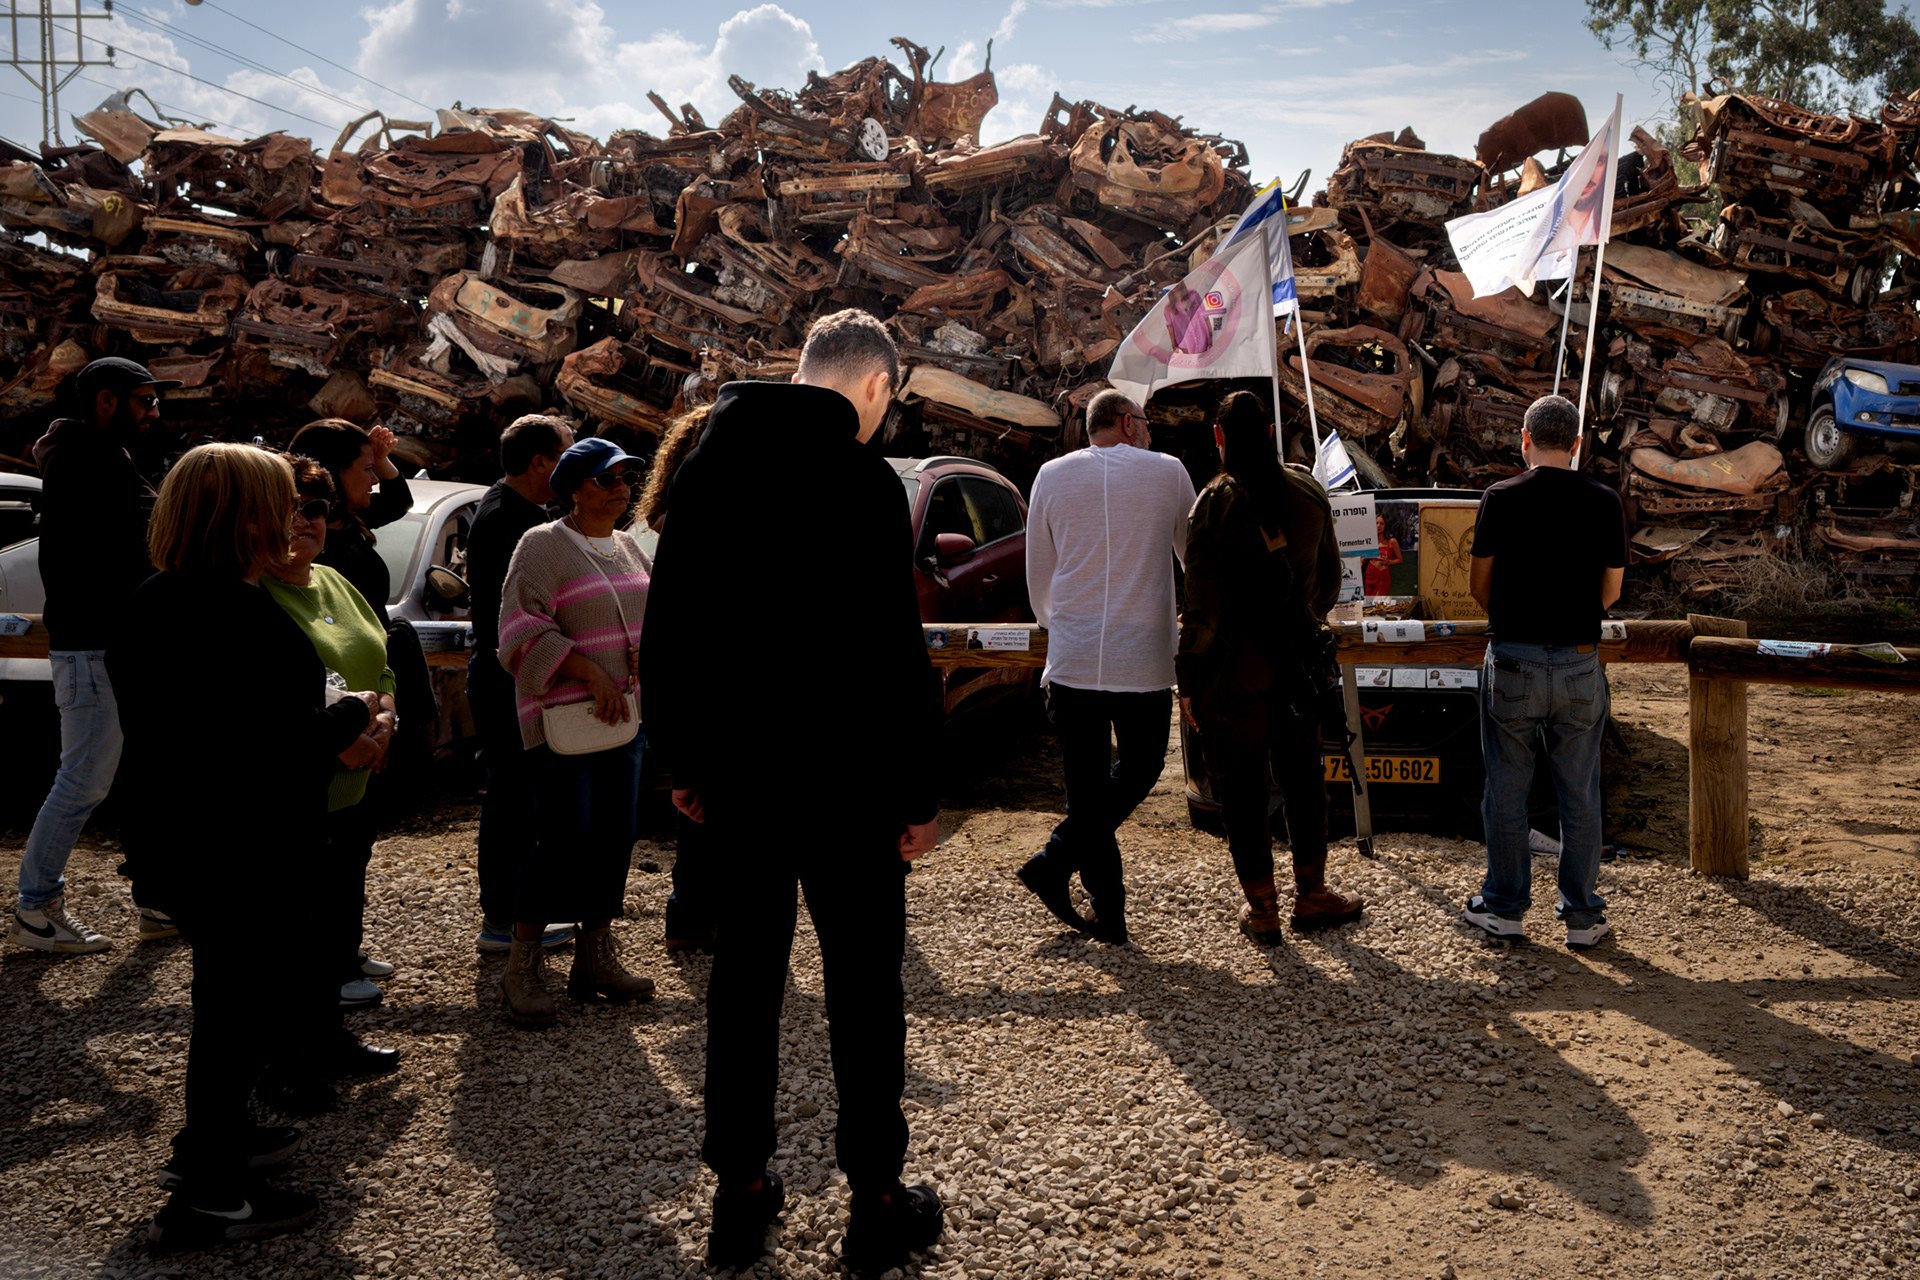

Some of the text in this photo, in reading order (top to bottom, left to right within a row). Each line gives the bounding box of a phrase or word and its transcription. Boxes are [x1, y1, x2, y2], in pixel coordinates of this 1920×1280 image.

[1331, 507, 1367, 517] קופרה פו
[1338, 539, 1365, 547] Formentor
[1453, 609, 1486, 617] 1992-202
